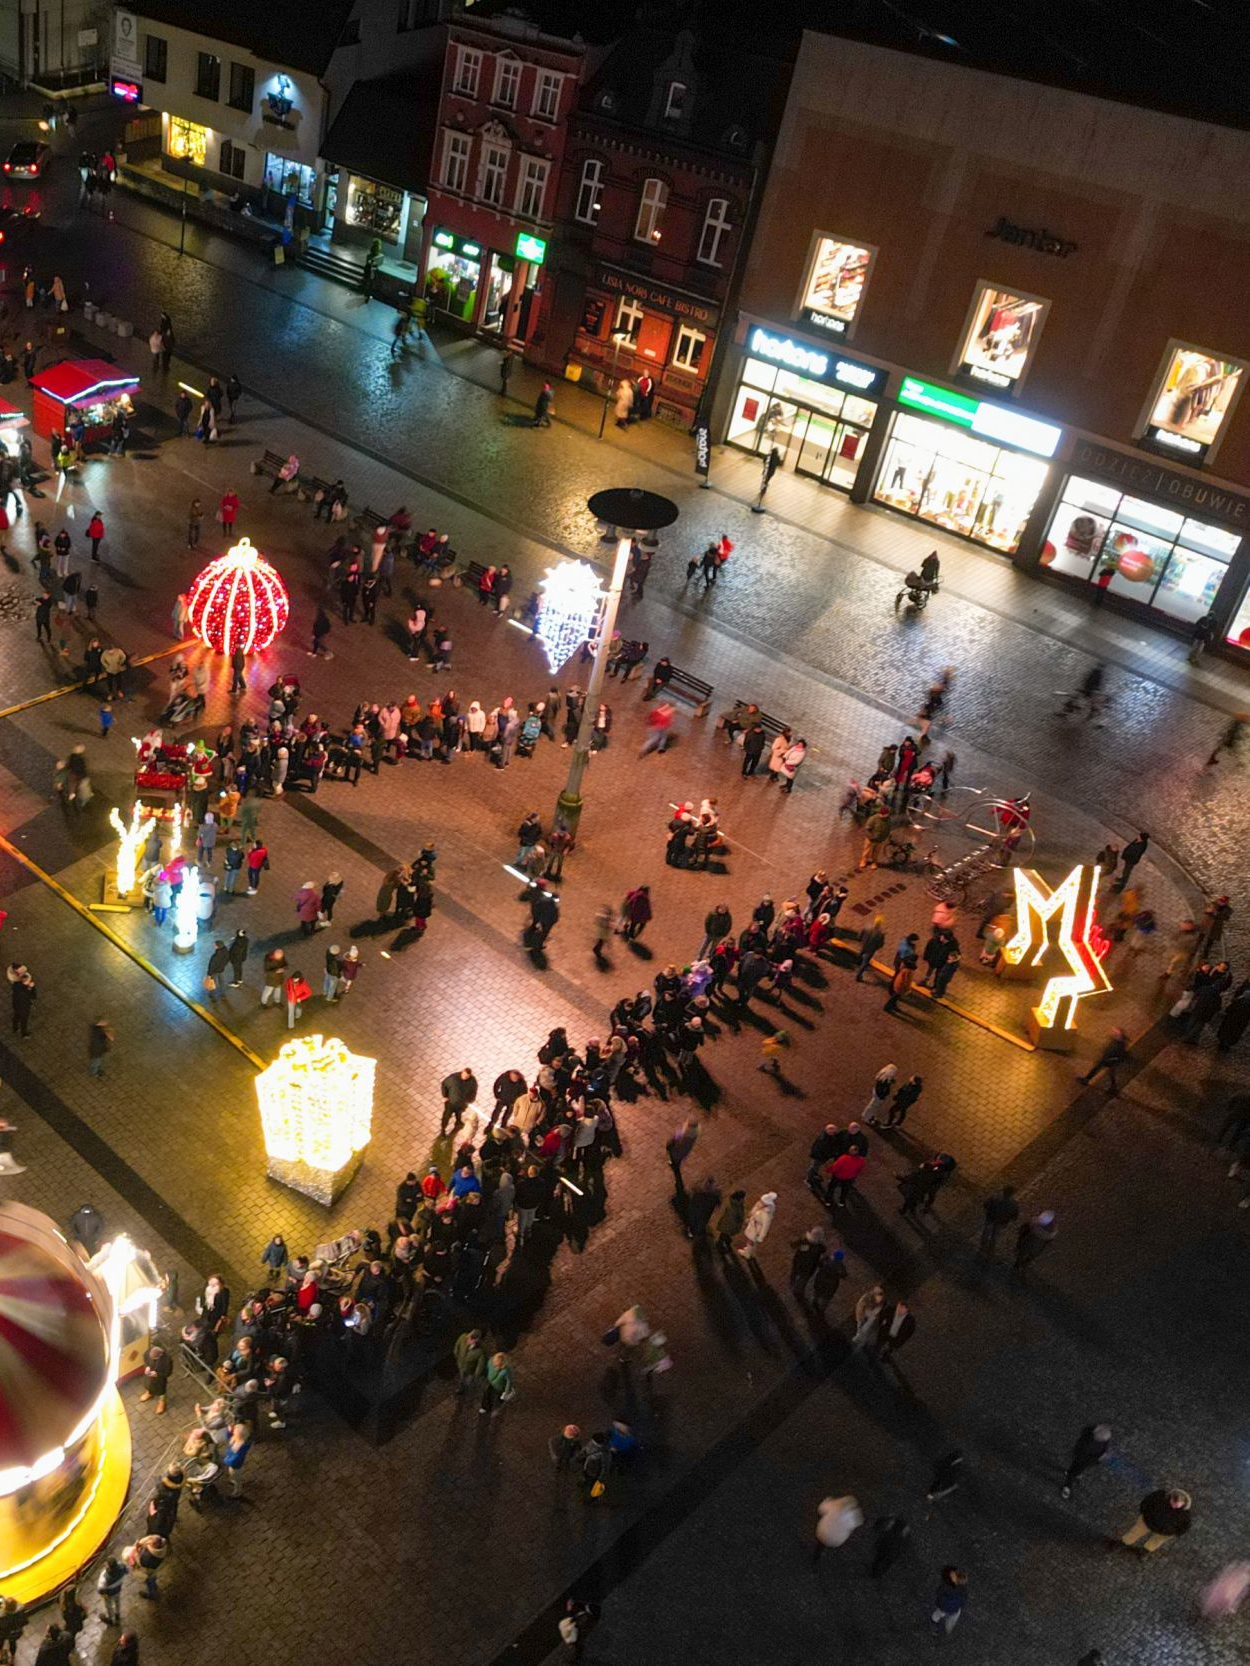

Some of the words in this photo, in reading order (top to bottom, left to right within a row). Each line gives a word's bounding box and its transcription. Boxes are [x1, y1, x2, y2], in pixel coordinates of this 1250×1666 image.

[674, 301, 708, 321] BISTRO
[752, 328, 828, 376] hortons
[1168, 479, 1246, 517] OBUWIE
